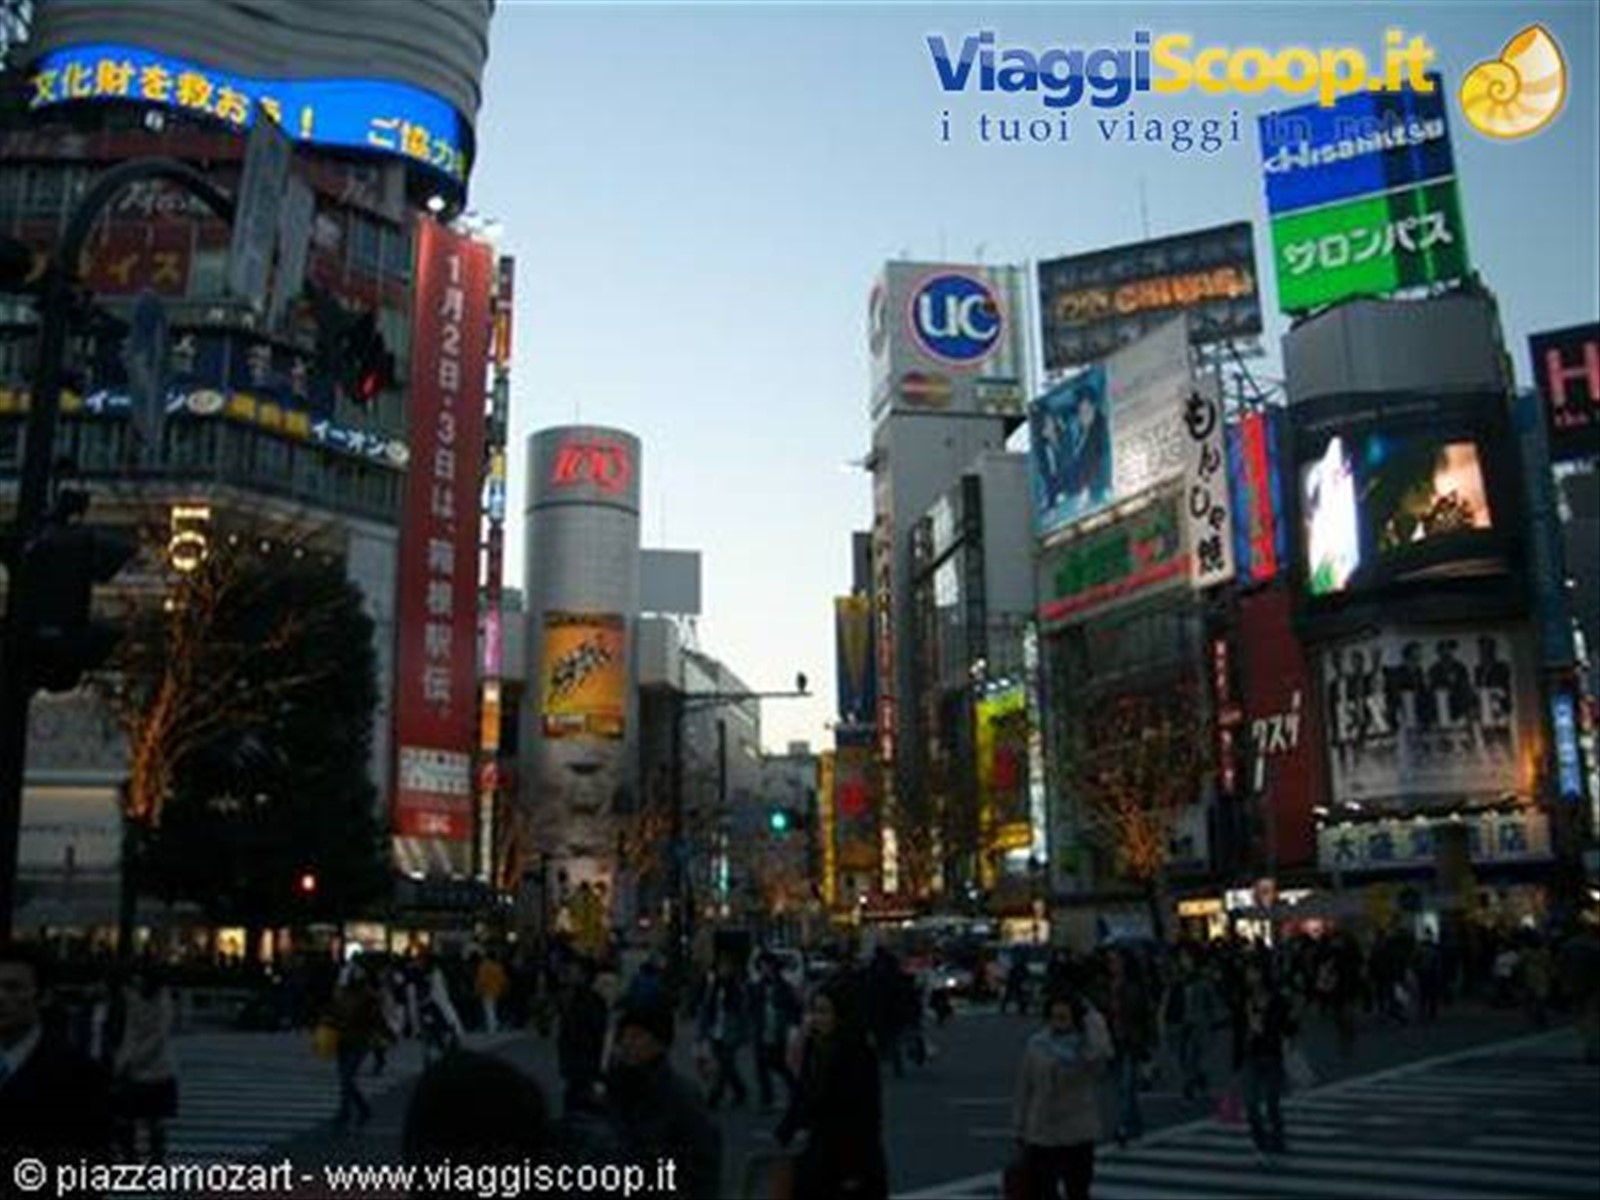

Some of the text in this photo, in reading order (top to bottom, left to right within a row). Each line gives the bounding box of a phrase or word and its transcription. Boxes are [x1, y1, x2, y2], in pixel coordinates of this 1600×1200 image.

[1282, 211, 1453, 274] サロンパス
[917, 293, 1000, 341] UC
[85, 389, 185, 413] イーン
[311, 419, 386, 456] イーオン
